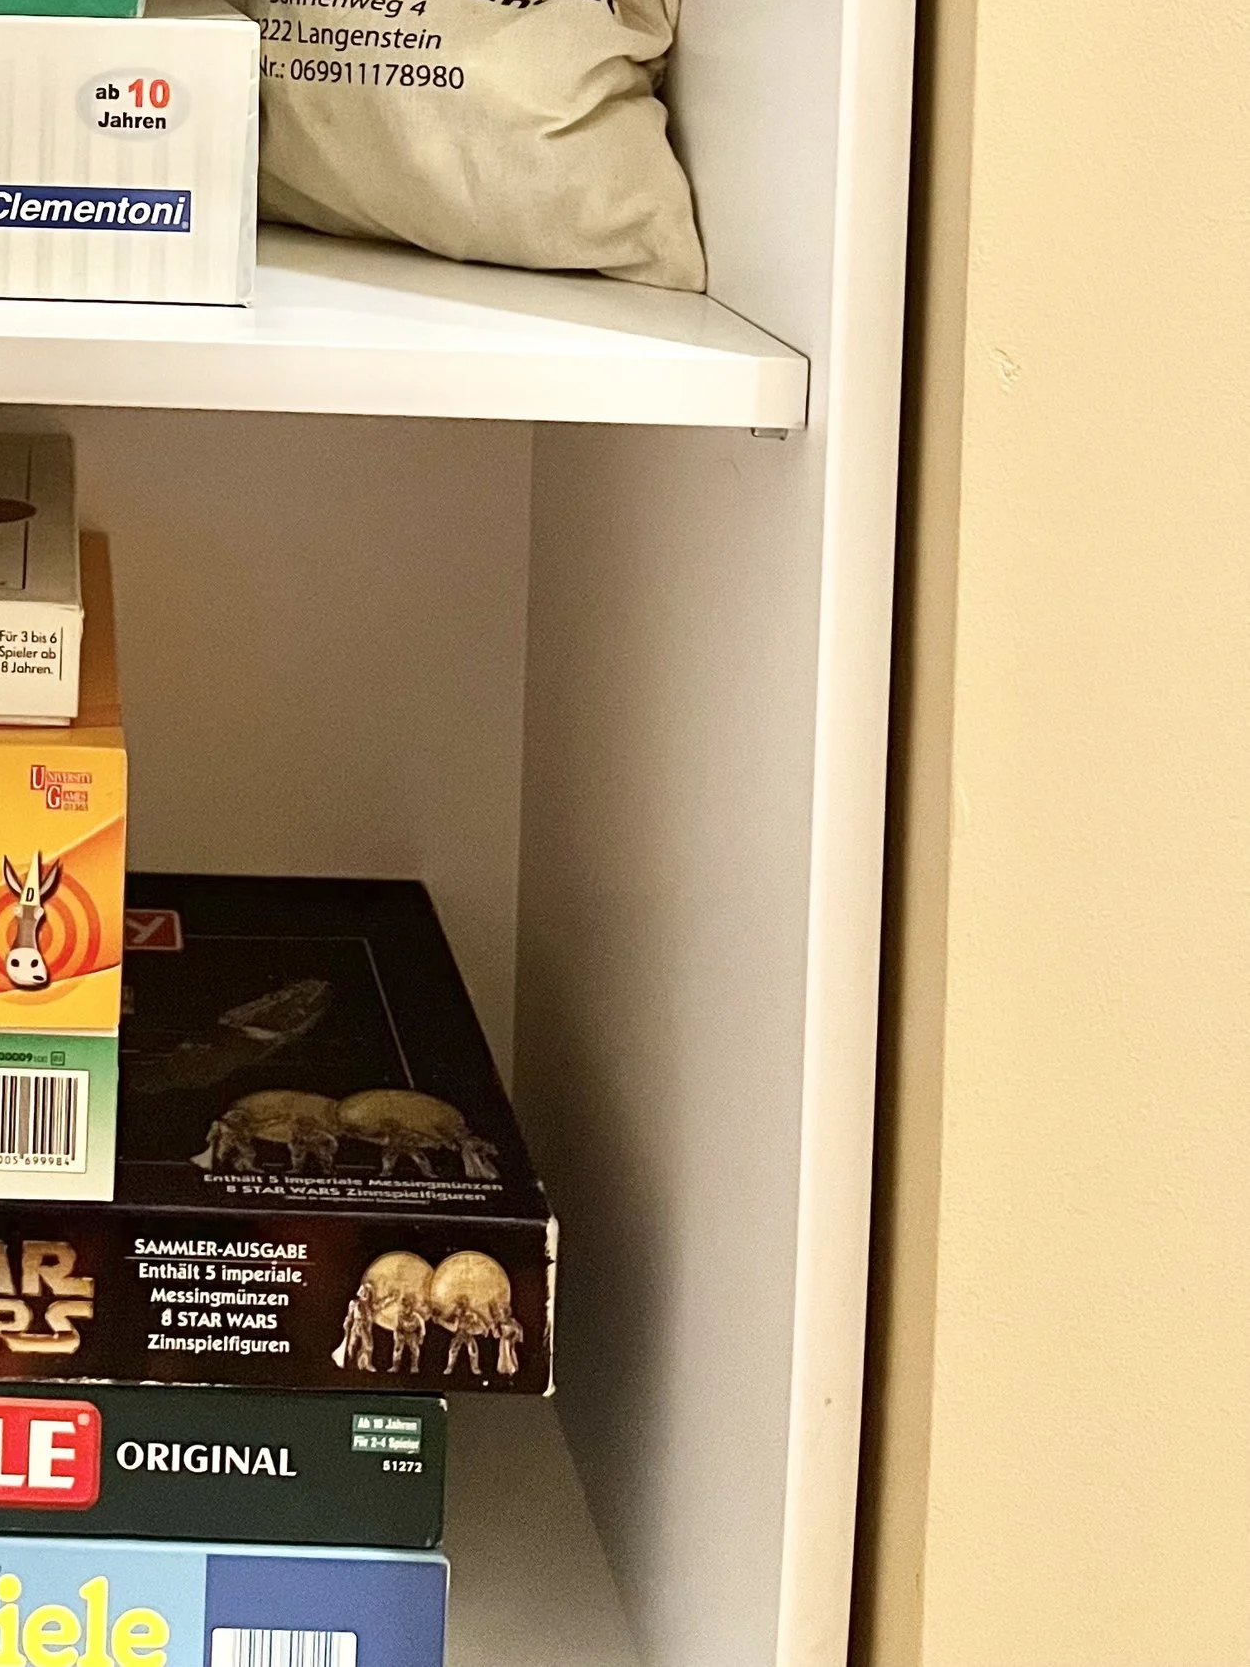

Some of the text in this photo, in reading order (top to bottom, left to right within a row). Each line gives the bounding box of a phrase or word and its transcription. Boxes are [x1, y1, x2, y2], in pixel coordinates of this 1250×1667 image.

[409, 0, 427, 16] 4
[297, 22, 442, 51] Langenstein
[290, 58, 465, 90] 069911178980
[94, 78, 171, 108] ab 10
[97, 111, 167, 129] Jahren
[21, 631, 28, 643] 3
[31, 631, 47, 643] bis
[49, 632, 57, 644] 6
[40, 647, 57, 660] ab
[1, 662, 9, 673] 8
[25, 887, 35, 903] D
[203, 1173, 503, 1192] Enthält 5 Messingmünzen
[242, 1185, 285, 1194] STAR
[289, 1186, 340, 1196] WARS
[346, 1187, 487, 1201] Zinnspielfiguren
[134, 1237, 308, 1261] SAMMLER-AUSGABE
[138, 1262, 303, 1287] Enthält 5 imperiale
[150, 1287, 289, 1309] Messingmünzen
[161, 1309, 278, 1330] 8 STAR WARS
[147, 1332, 291, 1355] Zinnspielfiguren
[115, 1439, 298, 1478] ORIGINAL
